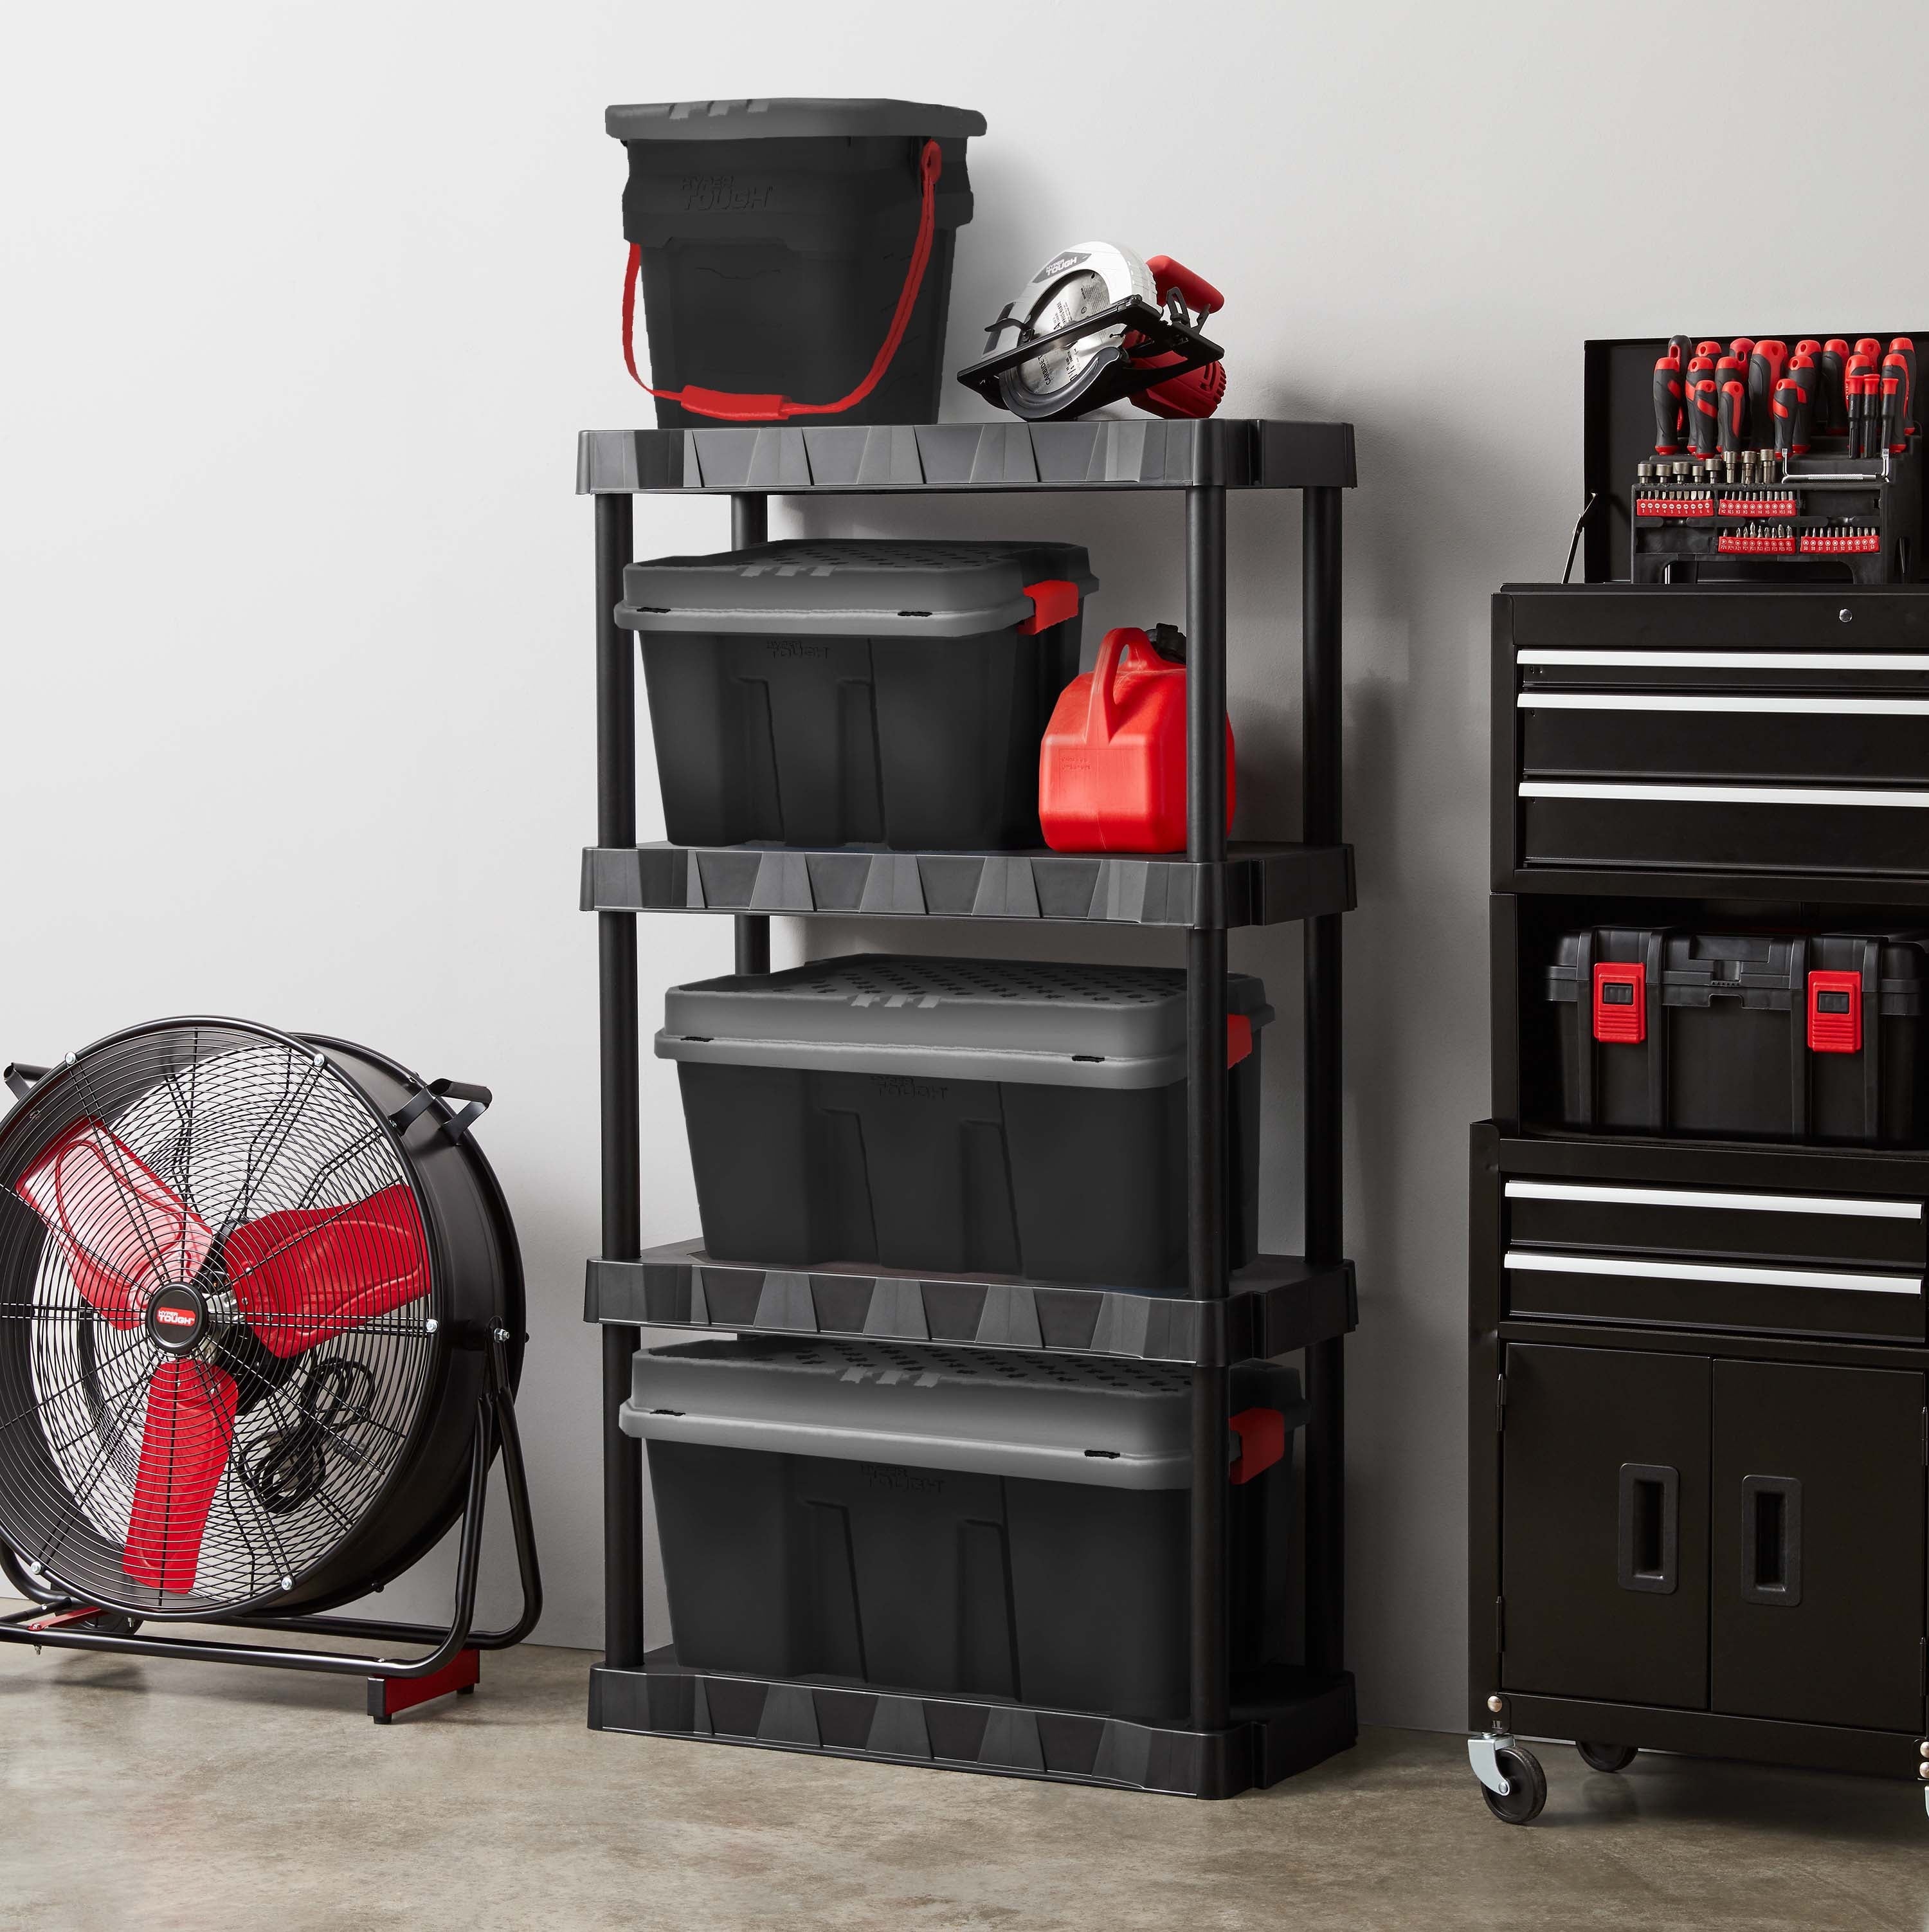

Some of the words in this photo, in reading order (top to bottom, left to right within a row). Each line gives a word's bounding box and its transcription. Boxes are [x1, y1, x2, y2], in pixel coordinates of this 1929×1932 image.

[1046, 257, 1078, 276] TOUGH
[1038, 360, 1051, 385] CARBIDE
[159, 1316, 192, 1325] TOUGH
